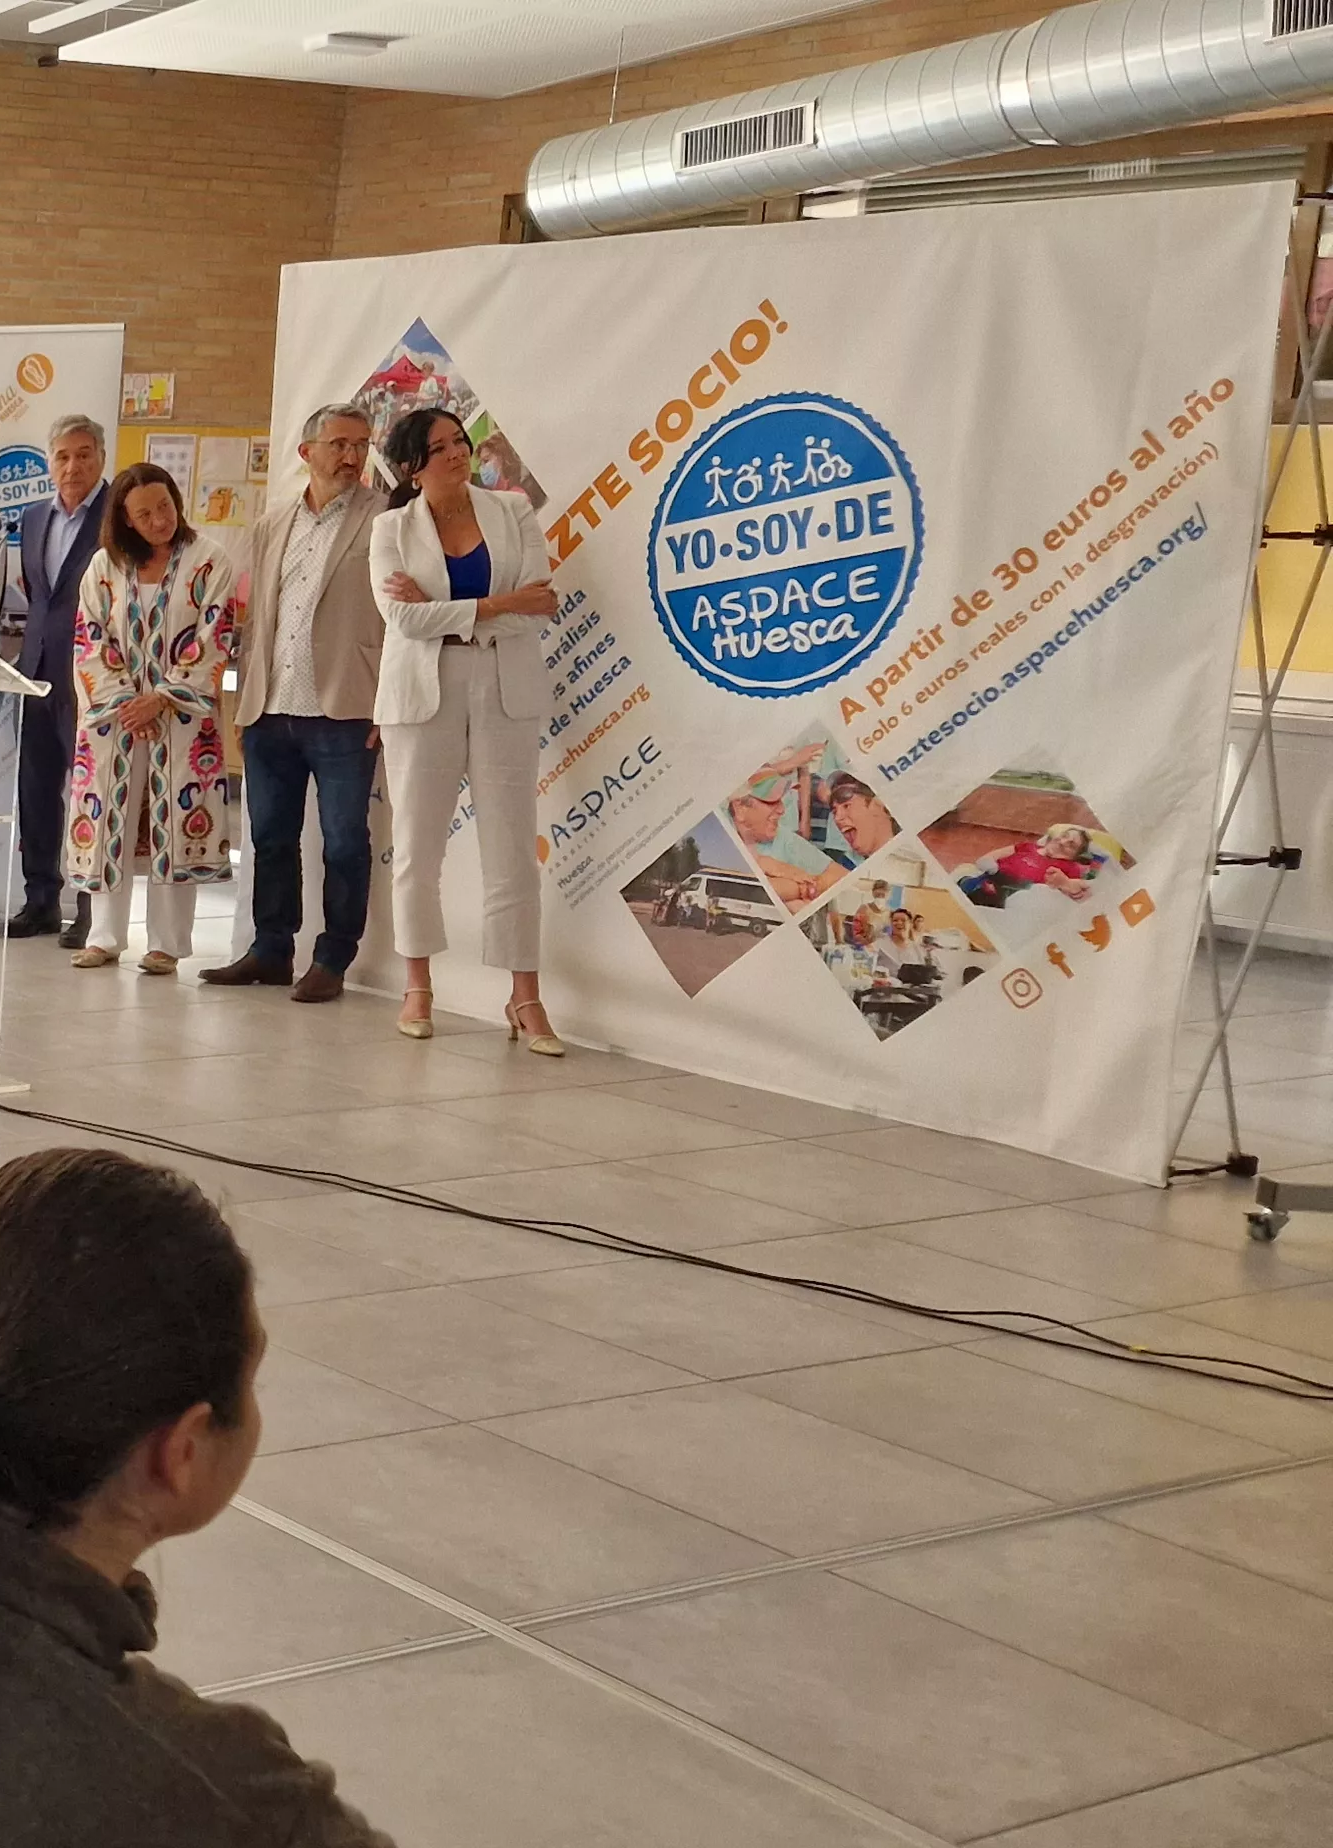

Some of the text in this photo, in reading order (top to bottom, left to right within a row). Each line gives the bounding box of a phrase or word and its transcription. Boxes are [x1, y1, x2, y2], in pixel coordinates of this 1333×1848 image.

[0, 396, 25, 421] HUESCA
[544, 298, 788, 572] ZTE SOCIO!
[840, 378, 1235, 725] A partir de 30 euros al año
[550, 589, 587, 626] vida
[692, 564, 881, 631] ASPACE
[856, 441, 1219, 755] (solo 6 euros reales con la desgravación)
[545, 610, 602, 671] arálisis
[566, 631, 616, 685] afines
[712, 612, 861, 661] Huesca
[878, 501, 1208, 782] haztesocio.aspacehuesca.org/
[549, 713, 572, 737] de
[569, 655, 632, 716] Huesca
[536, 683, 651, 797] pacehuesca.org
[550, 735, 662, 849] ASPACE
[557, 855, 594, 889] Huesca
